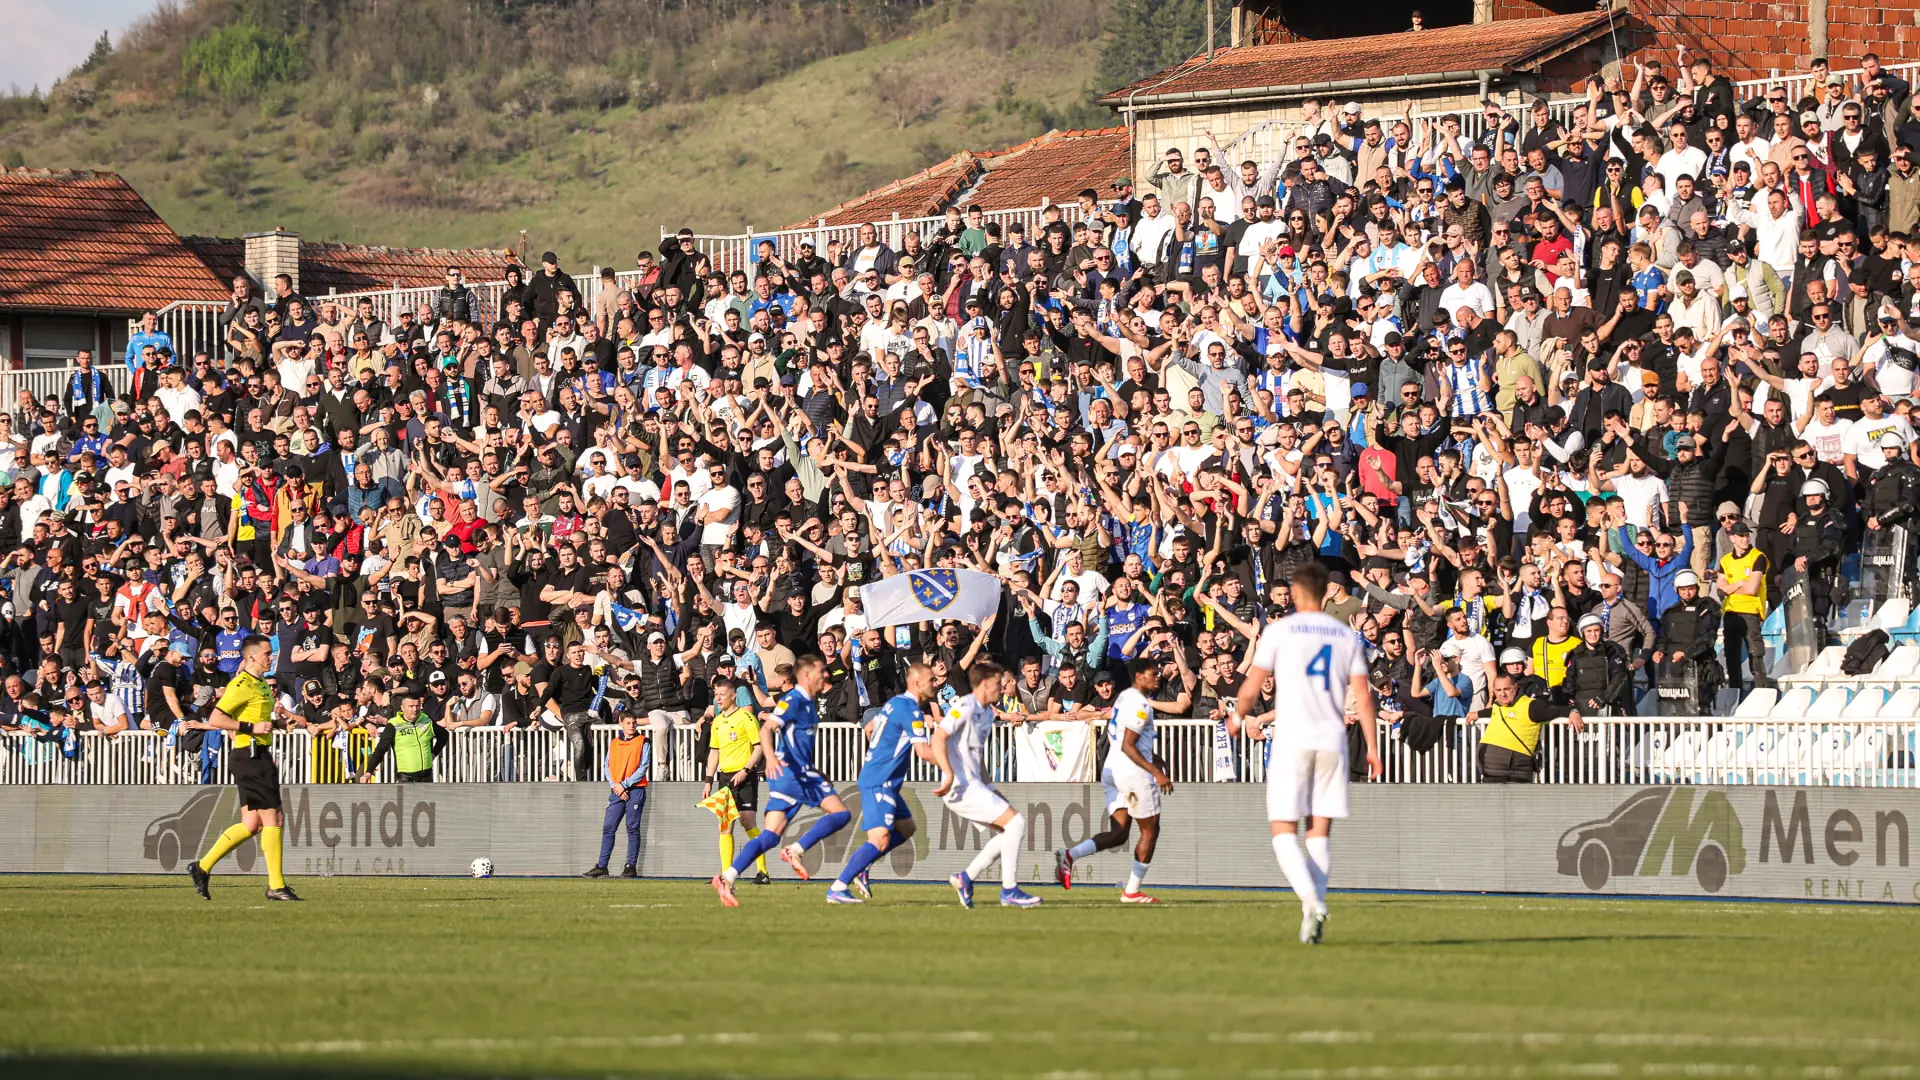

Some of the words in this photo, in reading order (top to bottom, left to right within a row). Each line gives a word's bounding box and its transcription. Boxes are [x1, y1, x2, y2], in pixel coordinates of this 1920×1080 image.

[1306, 644, 1332, 692] 4
[281, 785, 436, 848] Menda
[938, 784, 1130, 853] Mnd
[1758, 789, 1909, 866] Men
[305, 857, 344, 873] RENT
[354, 857, 363, 873] A
[372, 857, 406, 873] CAR
[1804, 878, 1864, 898] RENT
[1882, 881, 1894, 899] A
